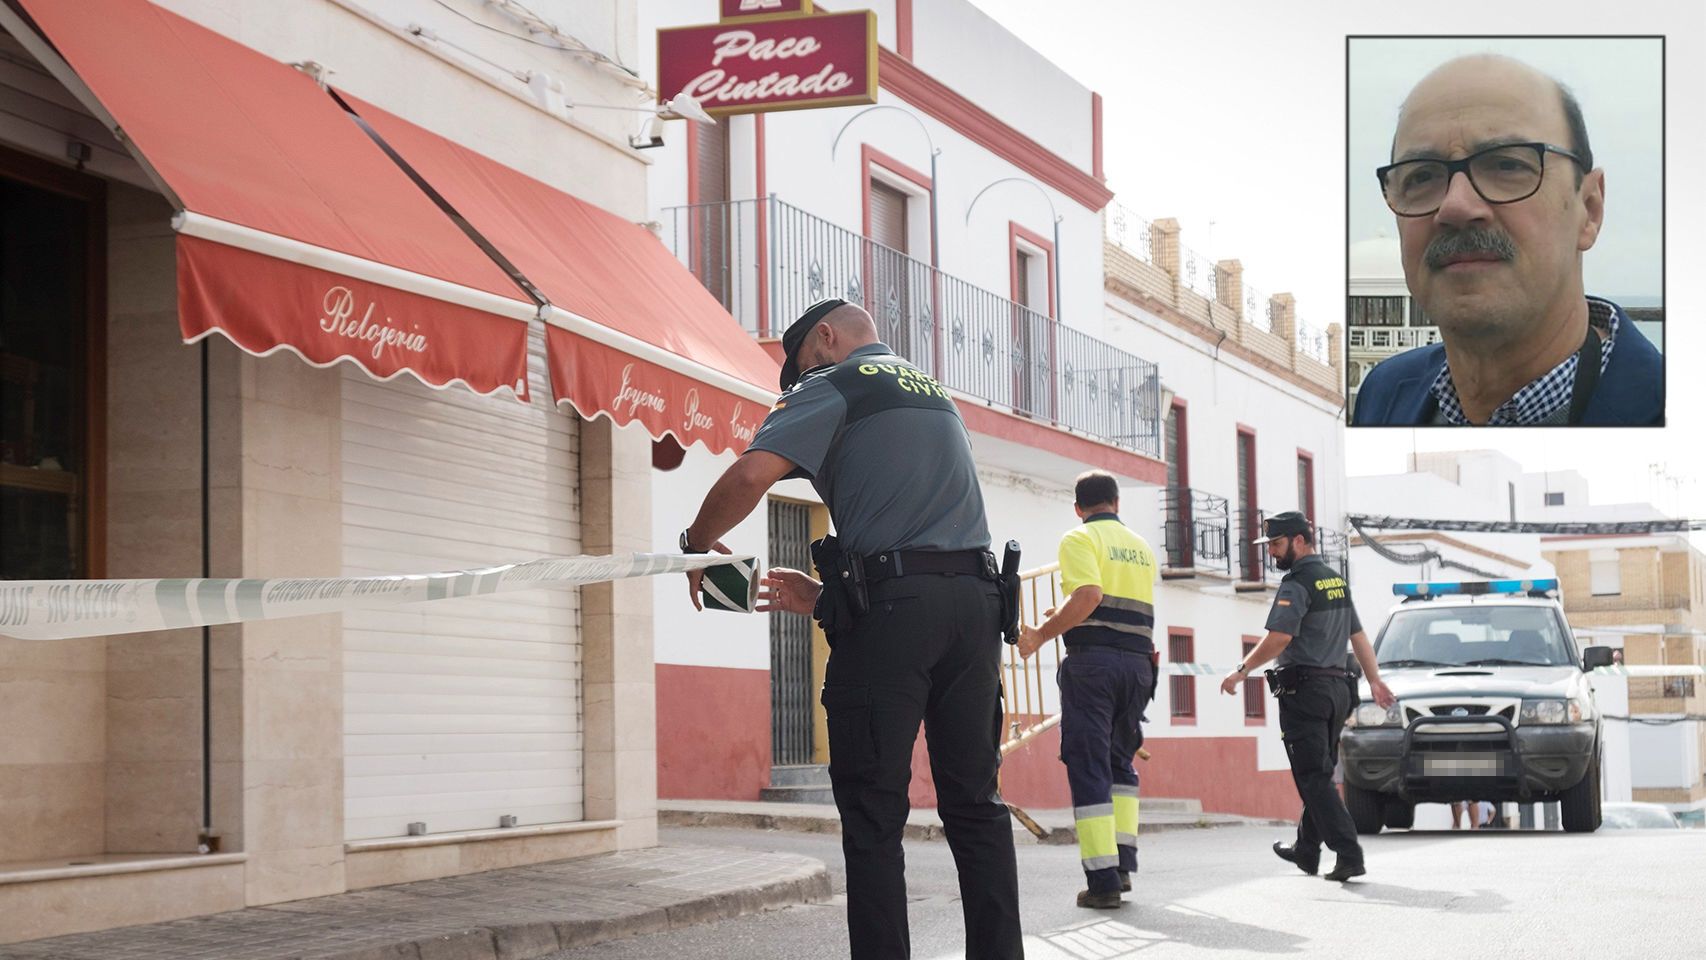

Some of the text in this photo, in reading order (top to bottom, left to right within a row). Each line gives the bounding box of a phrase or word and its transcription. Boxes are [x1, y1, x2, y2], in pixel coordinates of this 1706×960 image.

[712, 30, 821, 66] Paco
[681, 63, 853, 101] Cintado
[320, 286, 429, 360] Relojeria
[858, 363, 938, 386] GUARD
[612, 363, 758, 442] Joyeria Paco Cint
